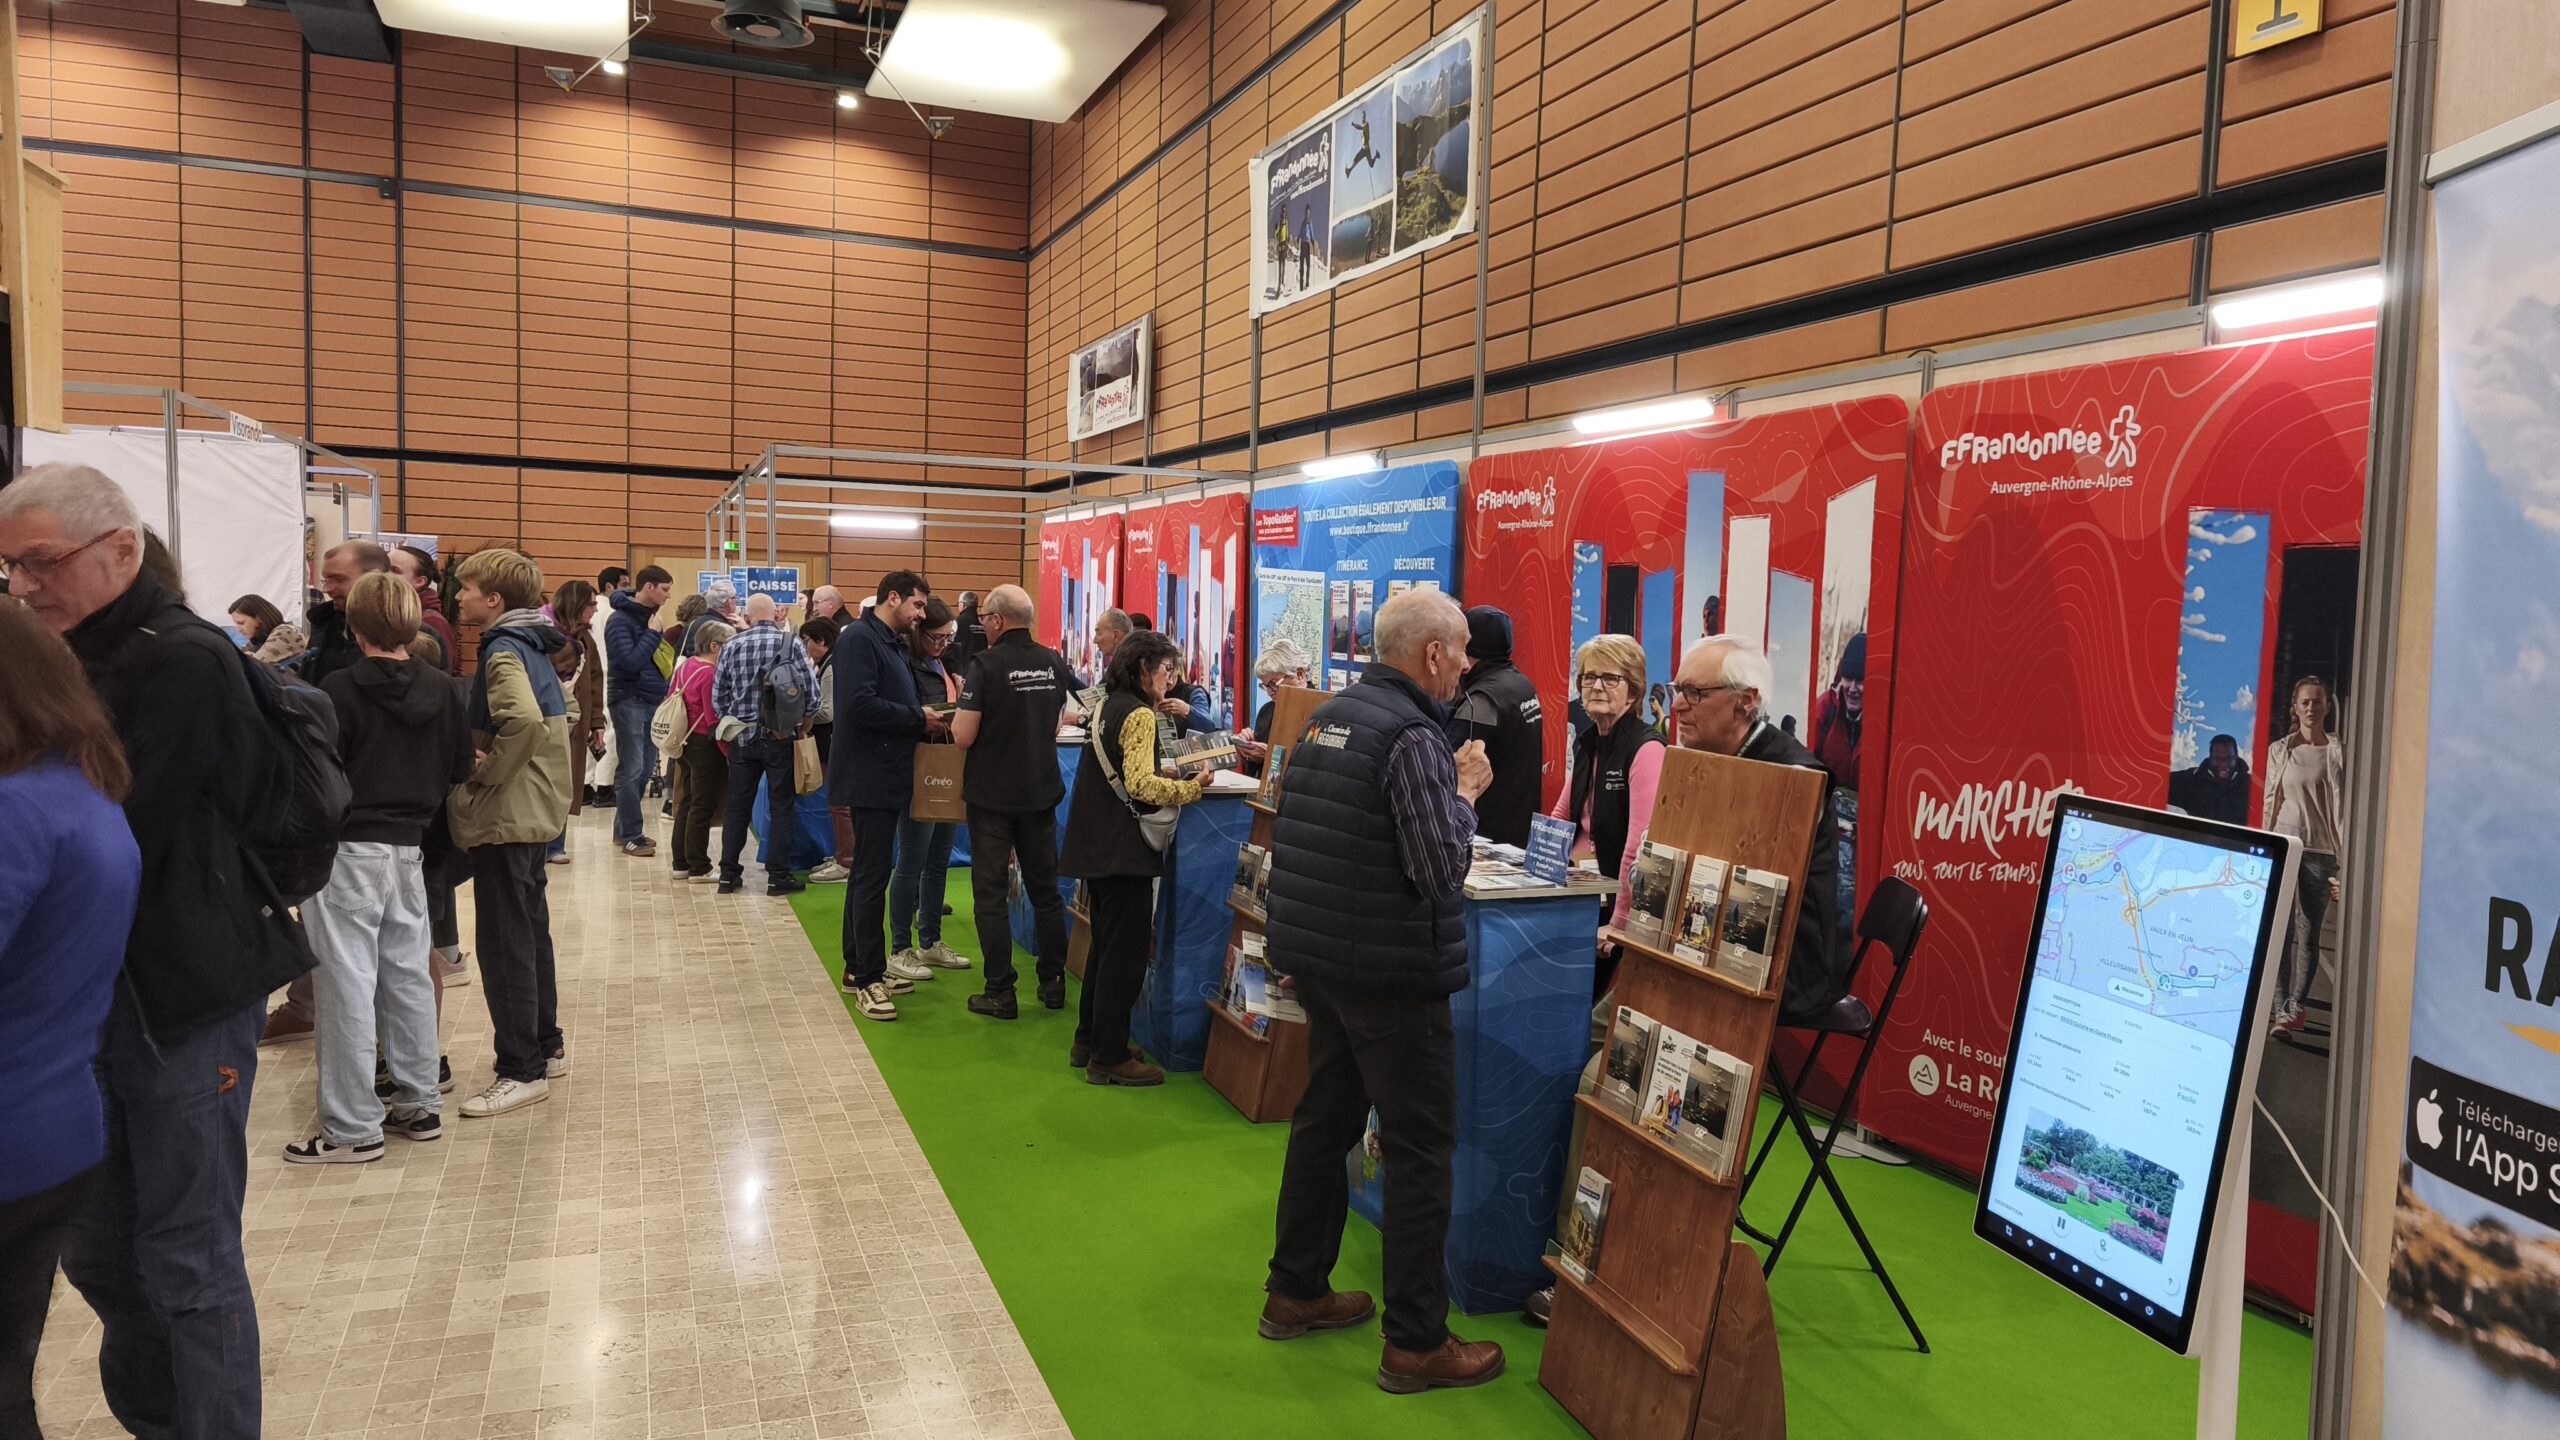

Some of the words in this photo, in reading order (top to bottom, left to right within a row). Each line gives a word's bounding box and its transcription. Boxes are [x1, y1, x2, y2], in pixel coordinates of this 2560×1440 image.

[1271, 149, 1319, 195] FFRandonnée
[231, 414, 262, 443] Visorando
[1941, 424, 2102, 468] FFRandonnée
[1990, 473, 2134, 496] Auvergne-Rhône-Alpes
[1303, 510, 1320, 523] TOUTE
[1326, 506, 1359, 520] COLLECTION
[1358, 501, 1393, 518] ÉGALEMENT
[1393, 498, 1431, 514] DISPONIBLE
[1431, 496, 1447, 510] SUR
[1477, 486, 1542, 512] FFRandonnée
[1497, 518, 1554, 531] Auvergne-Rhône-Alpes
[1336, 557, 1369, 572] ITINÉRANCE
[1394, 555, 1435, 571] DÉCOUVERTE
[1969, 861, 1988, 882] LE
[1922, 1028, 1955, 1052] Avec
[1959, 1038, 1972, 1058] le
[1946, 1063, 1972, 1093] La
[1945, 1094, 1993, 1120] Auvergne
[2176, 1091, 2197, 1105] Facile
[2456, 1096, 2560, 1153] Télécharge
